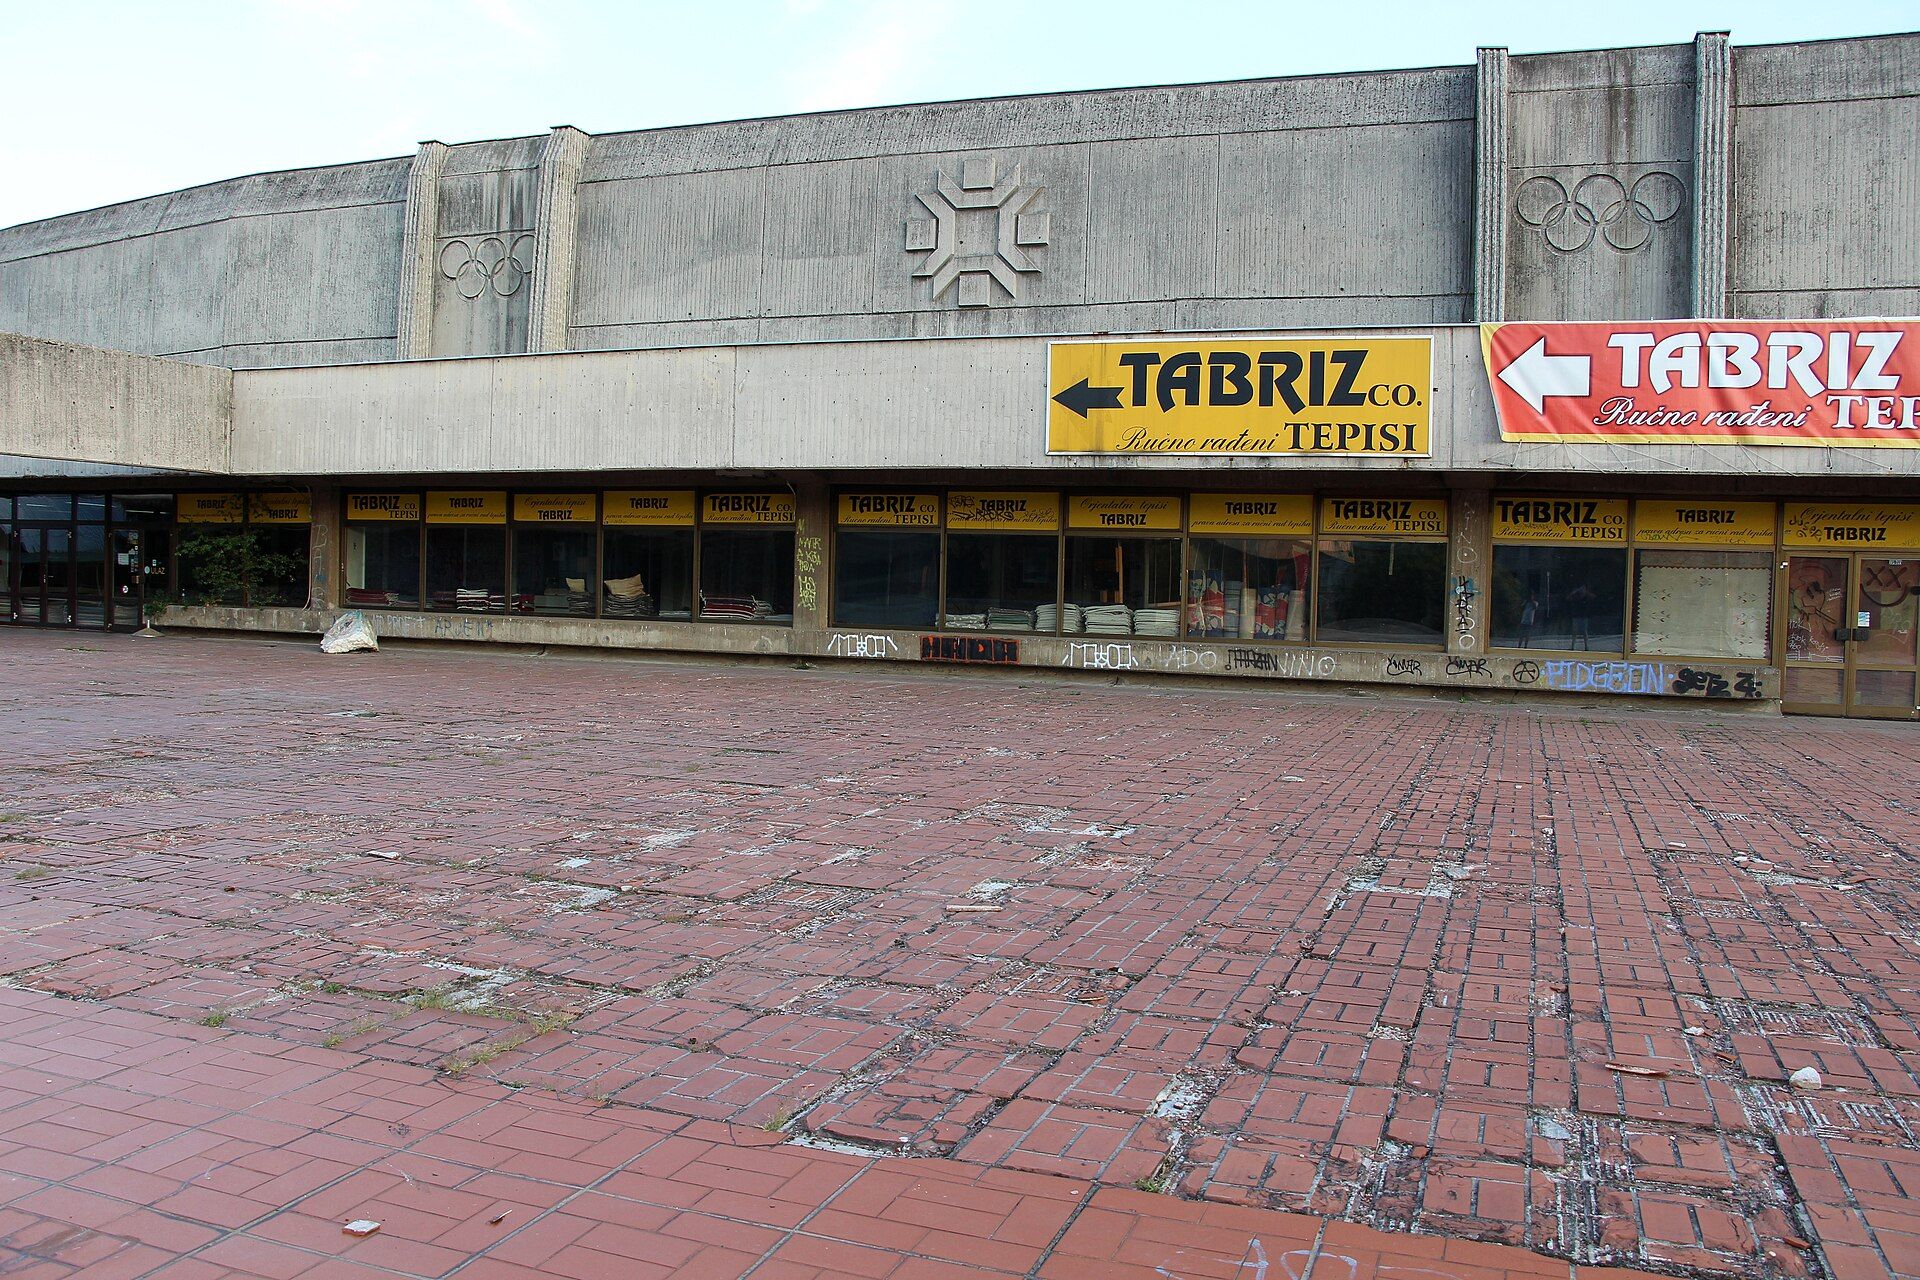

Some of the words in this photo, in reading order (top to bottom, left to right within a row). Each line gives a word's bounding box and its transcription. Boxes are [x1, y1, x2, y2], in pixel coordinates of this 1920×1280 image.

[1607, 331, 1904, 397] TABRIZ
[1118, 349, 1369, 415] TABRIZ
[1368, 383, 1423, 407] CO.
[1593, 397, 1697, 427] Ručno
[1701, 400, 1812, 428] rađeni
[1116, 426, 1197, 452] Ručno
[1200, 428, 1280, 452] rađeni
[1284, 421, 1418, 452] TEPISI
[196, 499, 226, 510] TABRIZ
[352, 495, 400, 511] TABRIZ
[448, 497, 484, 508] TABRIZ
[629, 497, 669, 510] TABRIZ
[710, 495, 772, 513] TABRIZ
[776, 503, 792, 512] CO.
[849, 495, 915, 514] TABRIZ
[919, 504, 936, 513] CO.
[979, 499, 1027, 512] TABRIZ
[1139, 500, 1169, 512] tepisi
[1225, 502, 1278, 516] TABRIZ
[268, 508, 299, 519] TABRIZ
[388, 510, 418, 519] TEPISI
[537, 509, 573, 520] TABRIZ
[756, 511, 794, 522] TEPISI
[1331, 500, 1412, 521] TABRIZ
[1418, 510, 1439, 520] CO.
[1496, 500, 1599, 526] TABRIZ
[1602, 515, 1625, 525] CO.
[1676, 509, 1735, 524] TABRIZ
[1800, 506, 1874, 525] Orjentalni
[1875, 510, 1914, 525] tepisi
[894, 514, 934, 524] TEPISI
[1099, 513, 1147, 526] TABRIZ
[1392, 520, 1442, 531] TEPISI
[1569, 526, 1623, 539] TEPISI
[1823, 526, 1887, 542] TABRIZ
